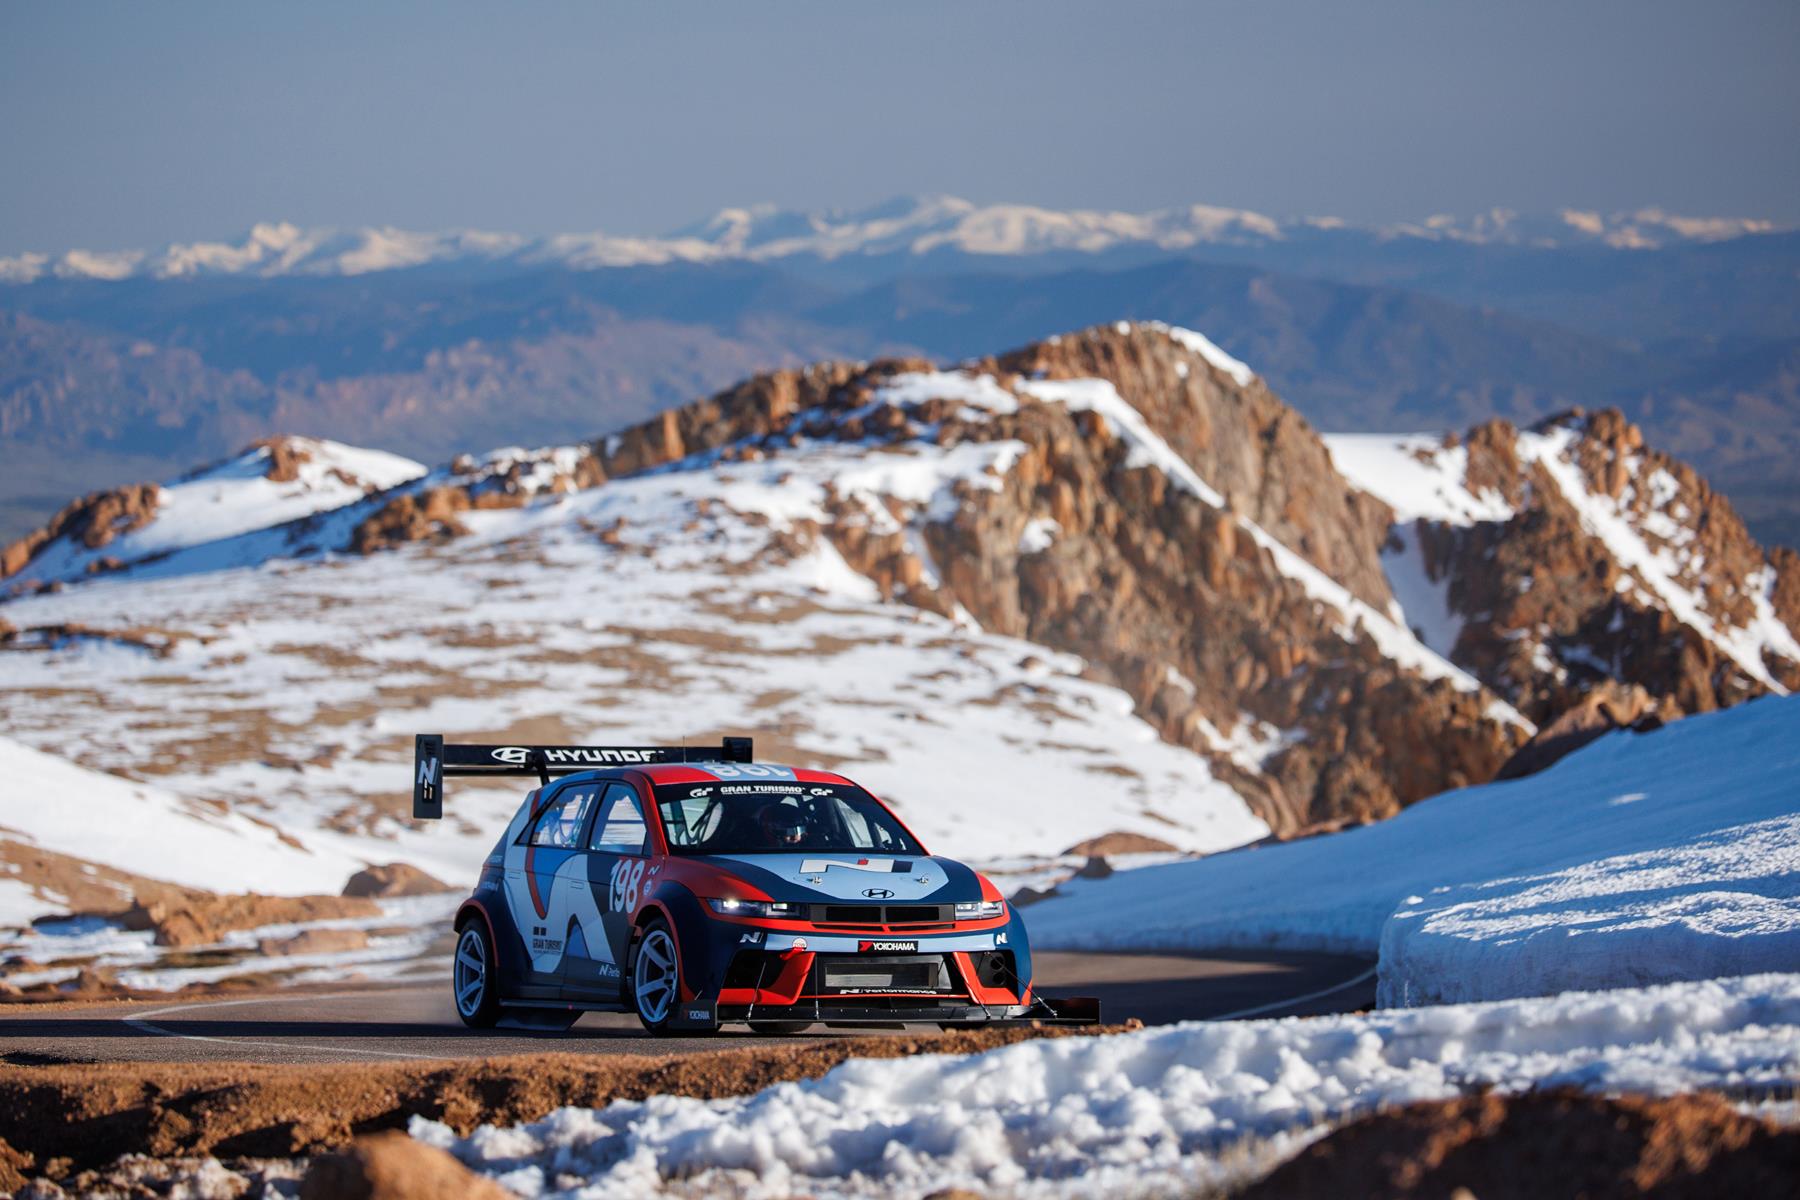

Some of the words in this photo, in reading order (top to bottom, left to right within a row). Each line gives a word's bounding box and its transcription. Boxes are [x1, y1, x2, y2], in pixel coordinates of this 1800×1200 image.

[544, 749, 665, 762] HYUNDA
[720, 785, 751, 793] GRAN
[753, 785, 803, 793] TURISMO
[608, 859, 646, 914] 198
[872, 941, 916, 951] YOKOHAMA
